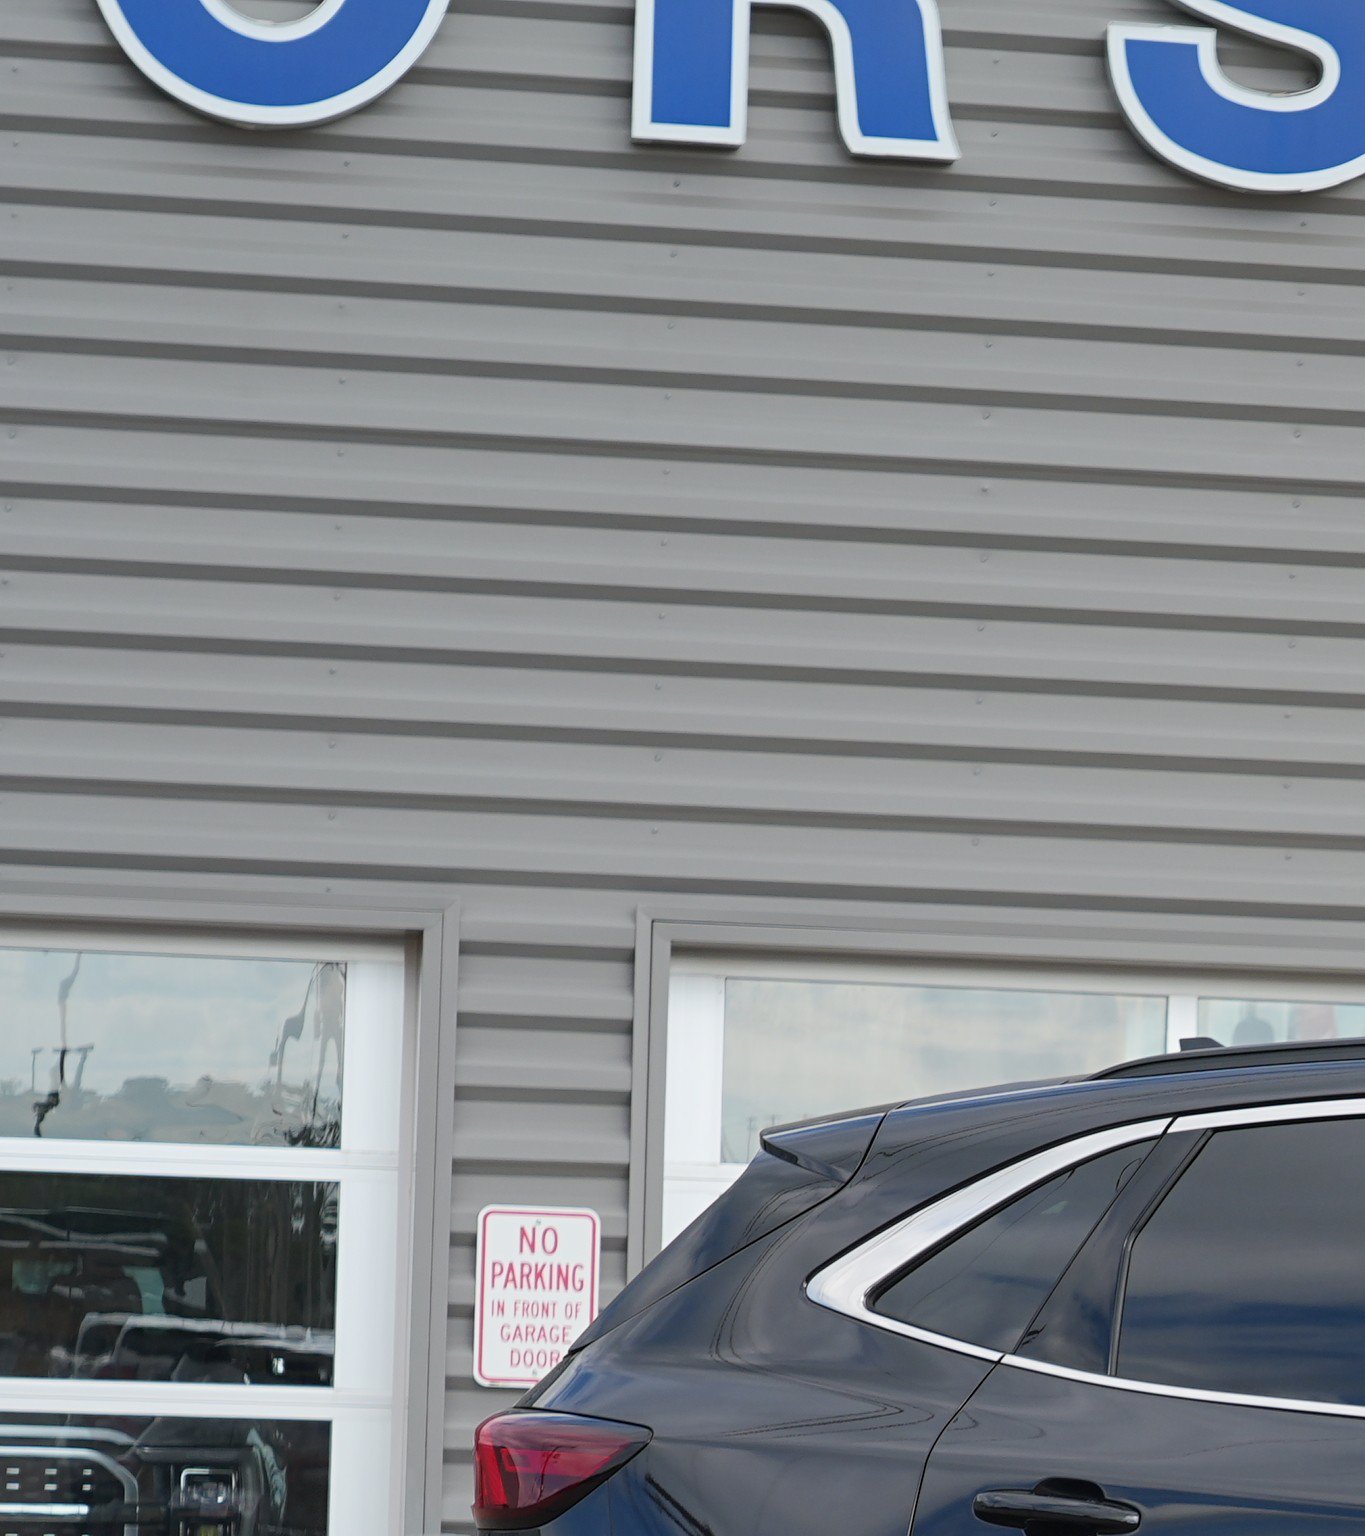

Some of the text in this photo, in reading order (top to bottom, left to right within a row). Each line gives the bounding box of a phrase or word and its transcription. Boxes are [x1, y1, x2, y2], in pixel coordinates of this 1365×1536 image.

[519, 1226, 559, 1255] NO
[491, 1261, 584, 1292] PARKING
[491, 1299, 582, 1319] IN FRONT OF
[500, 1324, 573, 1344] GARAGE
[510, 1348, 561, 1368] DOOR
